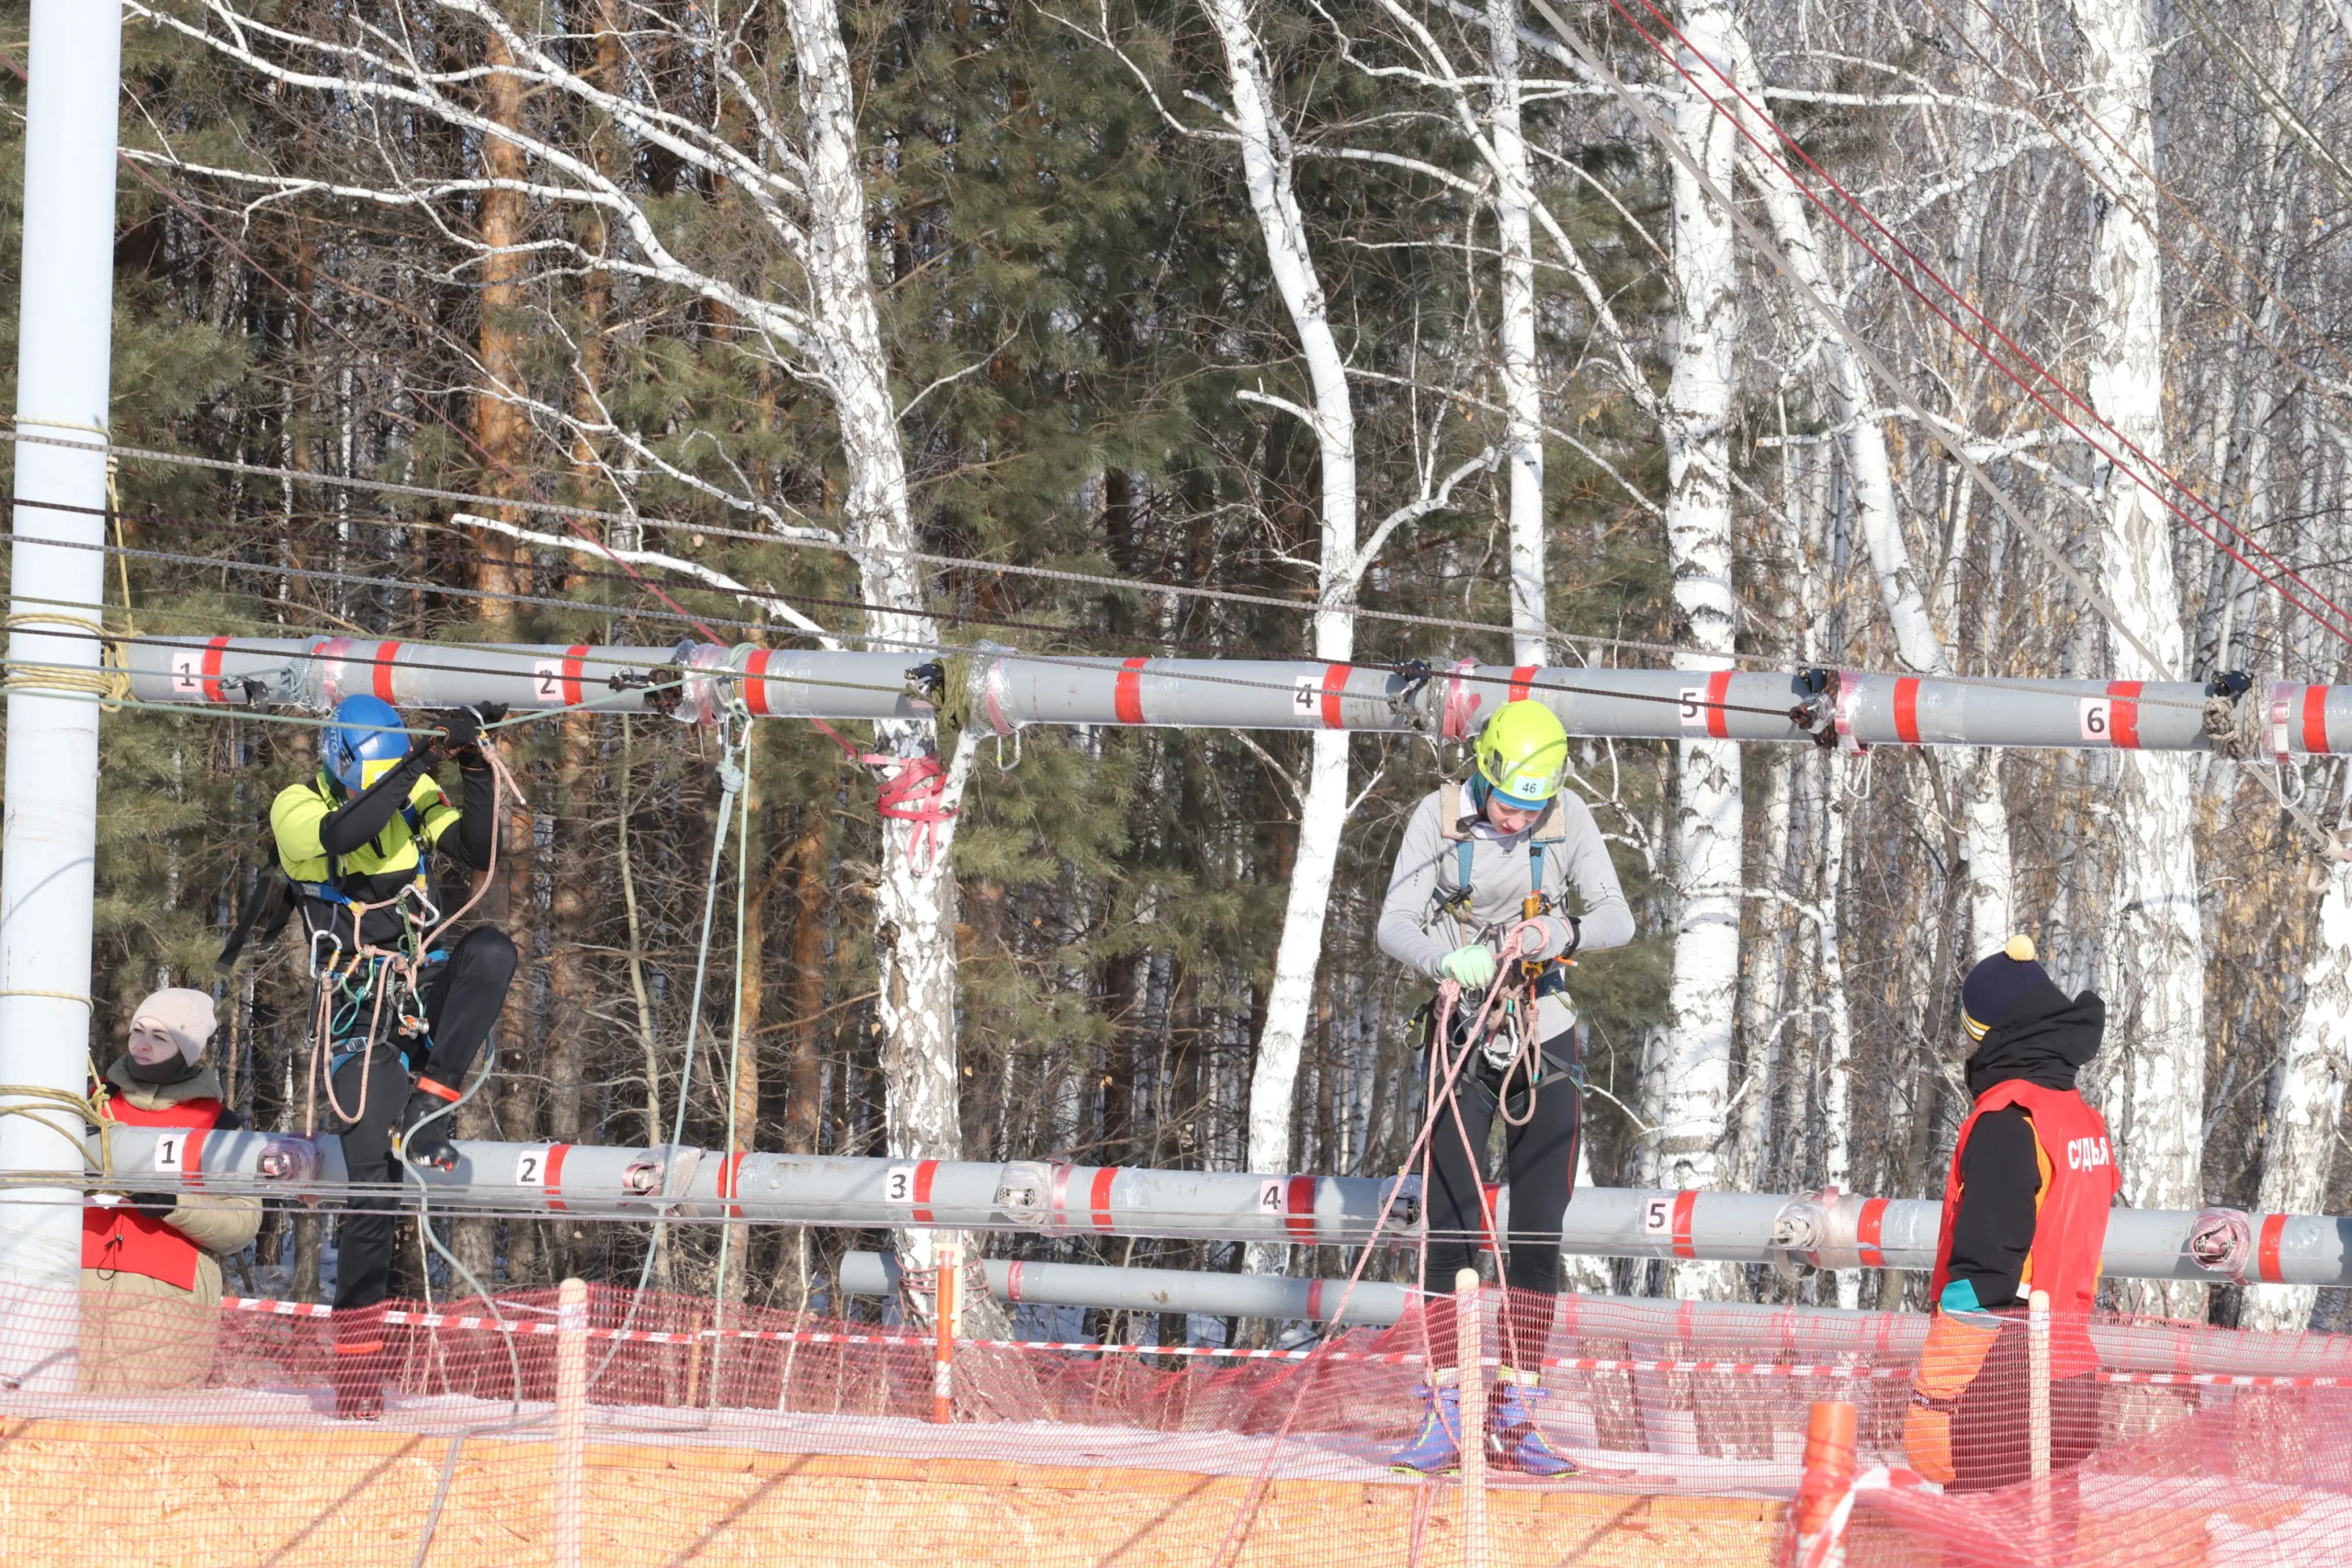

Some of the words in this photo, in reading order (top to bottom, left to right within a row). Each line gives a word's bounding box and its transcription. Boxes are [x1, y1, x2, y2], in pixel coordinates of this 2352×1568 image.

[180, 662, 196, 687] 1
[539, 670, 556, 694] 2
[1295, 683, 1314, 708] 4
[1682, 692, 1698, 718] 5
[2087, 707, 2105, 733] 6
[1521, 782, 1537, 794] 46
[162, 1140, 175, 1164] 1
[2067, 1136, 2109, 1173] СУДЬЯ
[521, 1157, 537, 1182] 2
[890, 1174, 907, 1199] 3
[1262, 1186, 1281, 1210] 4
[1648, 1203, 1666, 1228] 5
